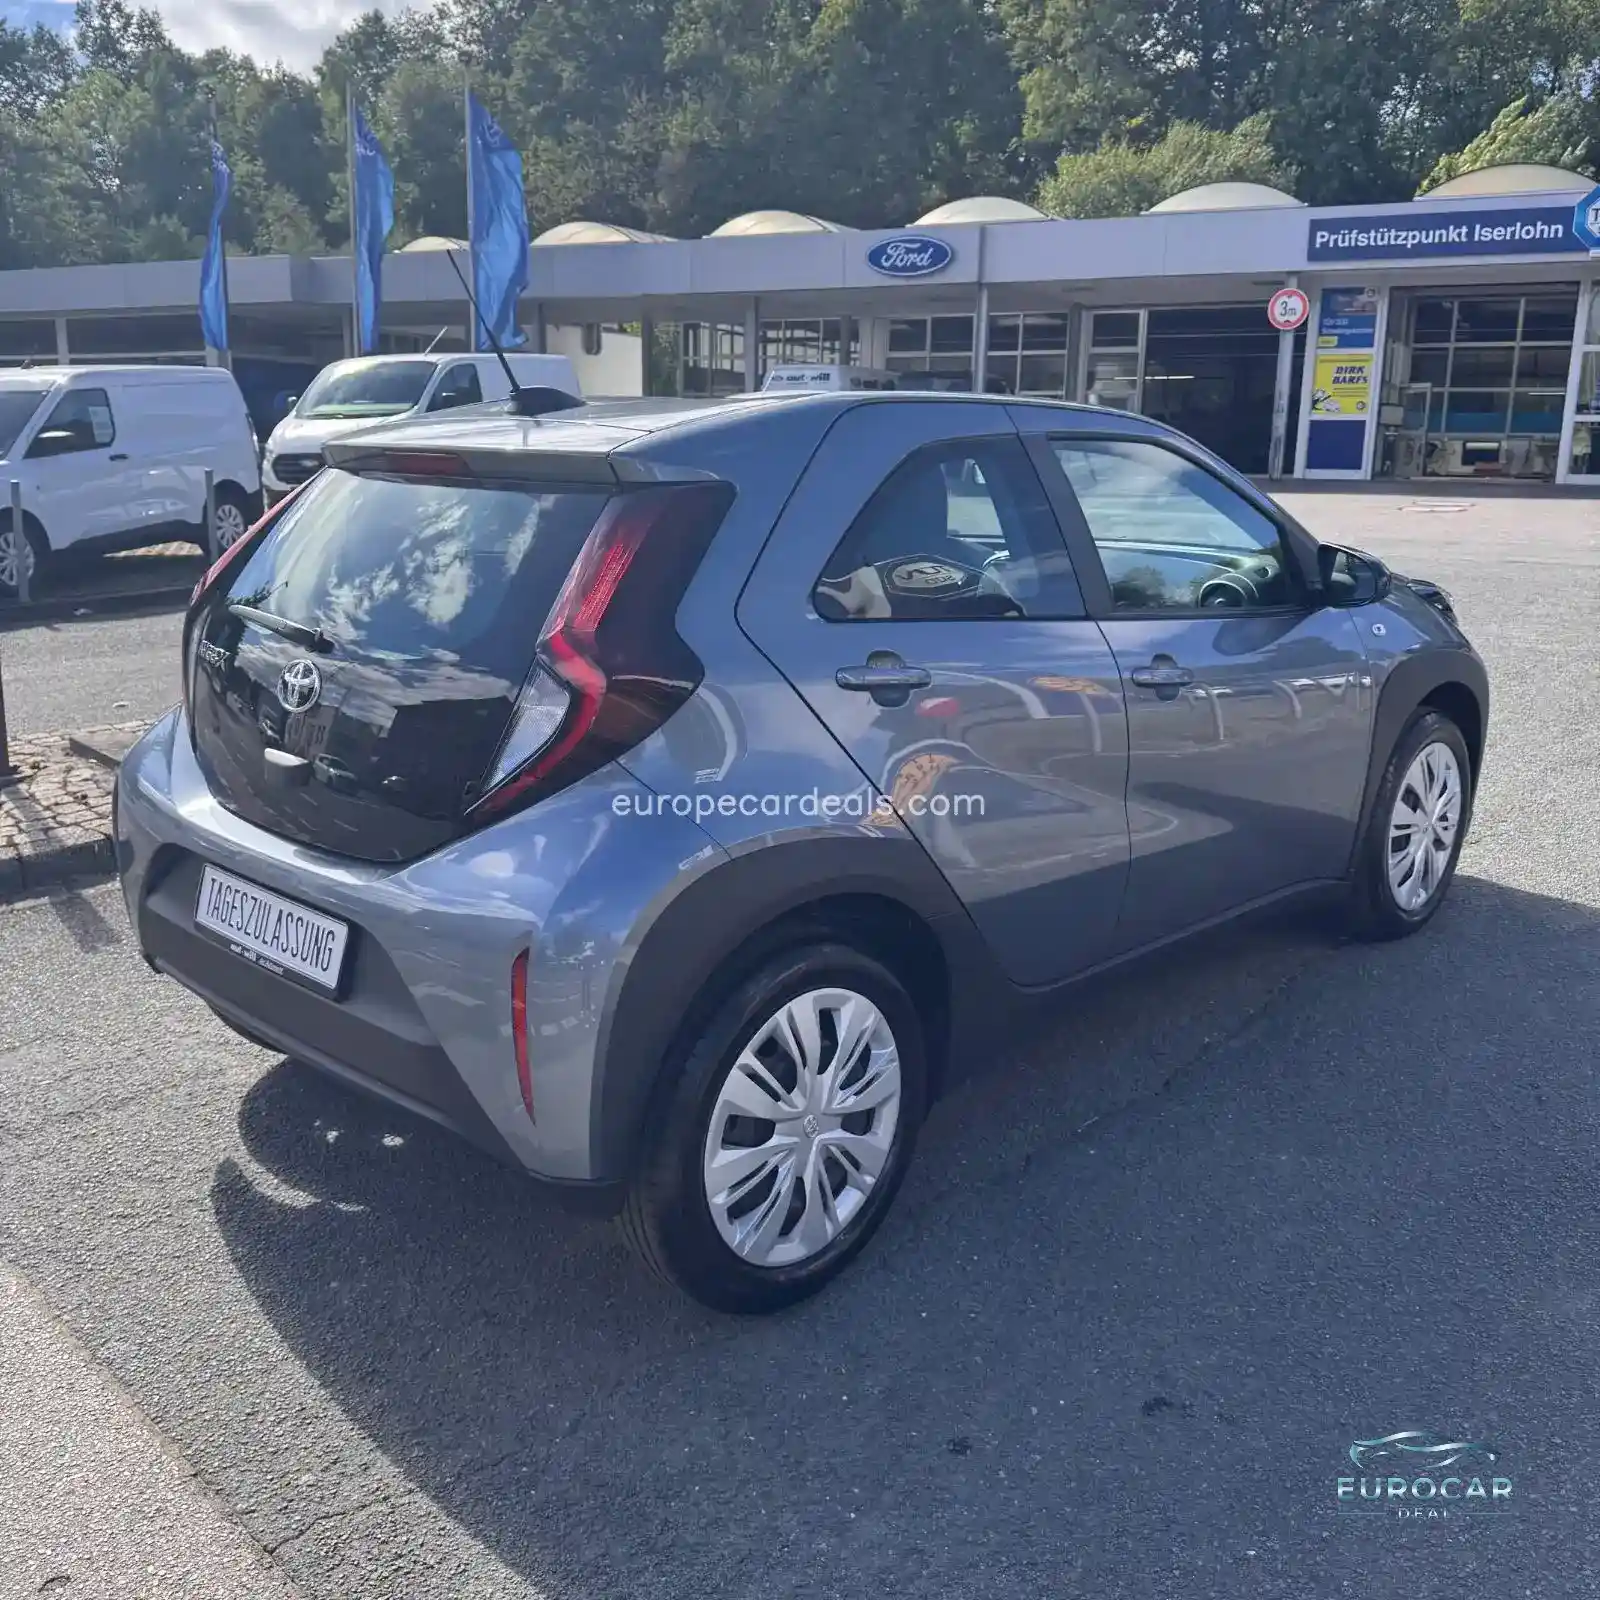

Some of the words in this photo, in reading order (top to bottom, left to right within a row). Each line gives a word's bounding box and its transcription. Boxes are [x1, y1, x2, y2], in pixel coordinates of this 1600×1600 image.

[1315, 225, 1468, 248] Prüfstützpunkt
[1474, 221, 1563, 242] Iserlohn
[881, 242, 934, 267] Ford
[206, 878, 335, 972] TAGESZULASSUNG
